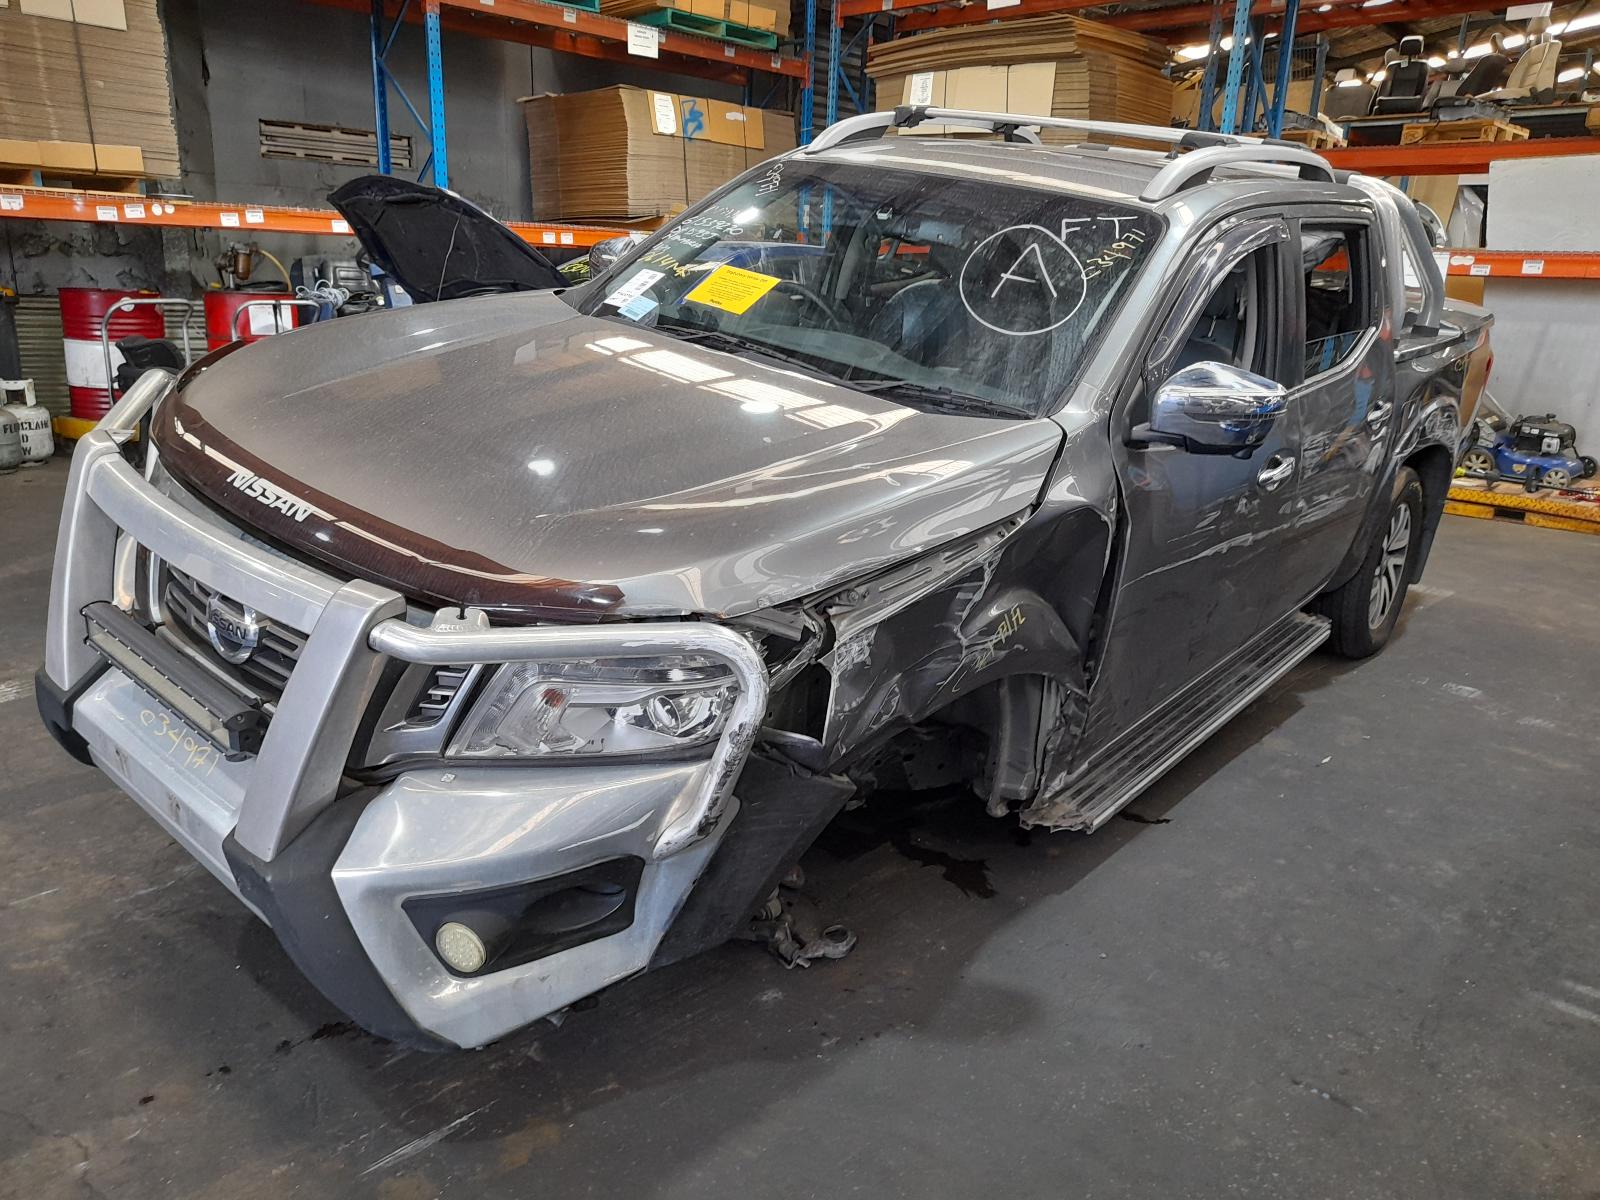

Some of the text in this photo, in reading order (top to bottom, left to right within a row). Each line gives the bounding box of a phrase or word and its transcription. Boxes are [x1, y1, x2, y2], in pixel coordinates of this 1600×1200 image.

[991, 242, 1058, 298] A
[226, 468, 313, 522] NISSAN
[140, 709, 220, 777] 034971
